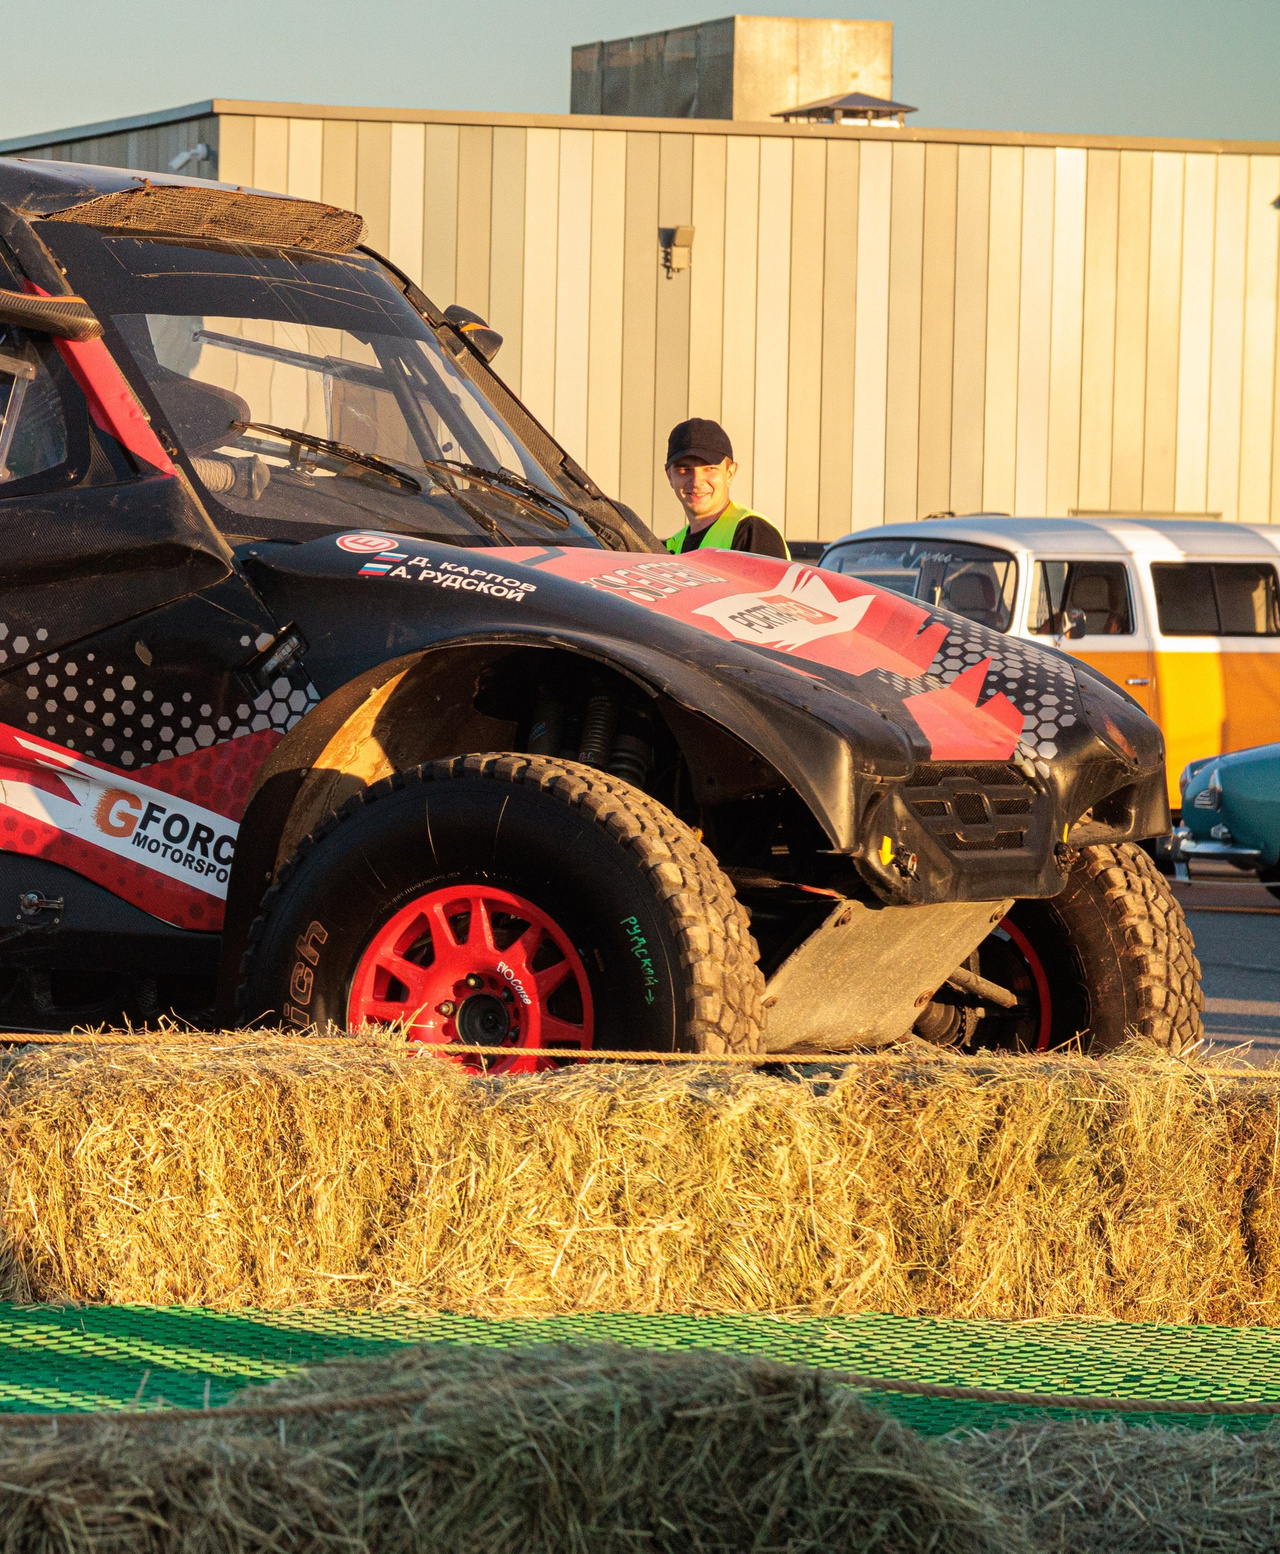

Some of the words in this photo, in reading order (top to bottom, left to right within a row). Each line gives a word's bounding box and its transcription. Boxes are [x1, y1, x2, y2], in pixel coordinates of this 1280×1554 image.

[390, 566, 412, 580] А.
[418, 569, 526, 602] РУДСКОЙ
[408, 556, 432, 567] Д.
[440, 562, 538, 593] КАРПОВ
[91, 787, 236, 866] GFORC
[131, 831, 229, 884] MOTORSPO
